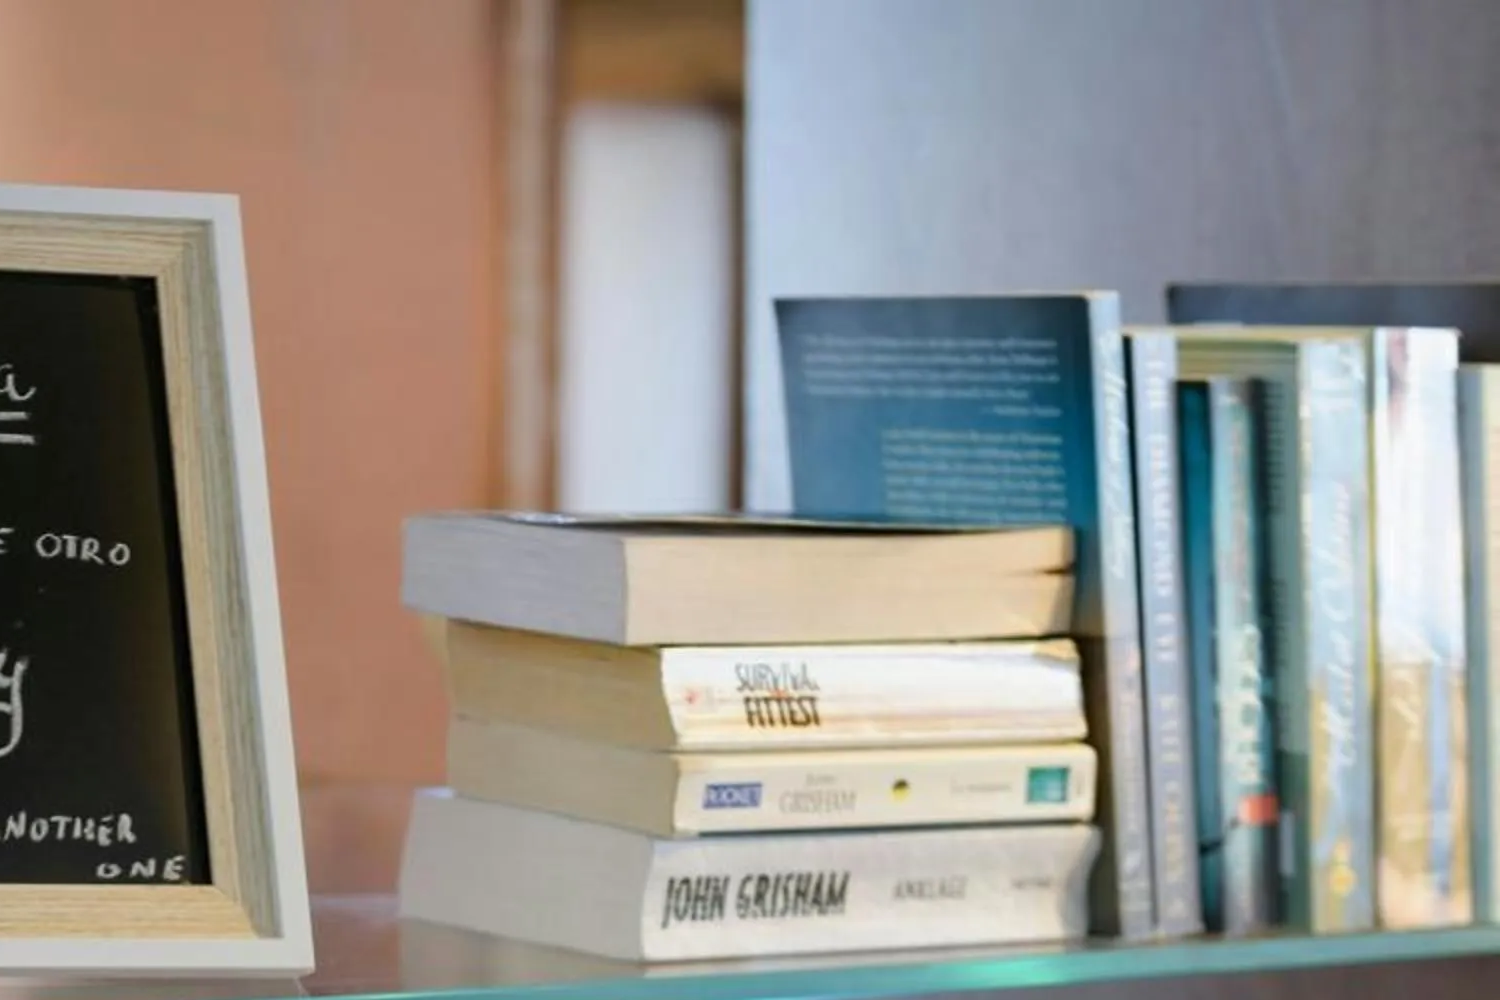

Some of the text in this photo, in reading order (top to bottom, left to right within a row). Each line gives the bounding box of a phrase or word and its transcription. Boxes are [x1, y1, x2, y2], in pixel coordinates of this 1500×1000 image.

[36, 534, 130, 565] OTRO
[96, 855, 185, 880] ONE
[661, 870, 850, 930] JOHN GRISHAM
